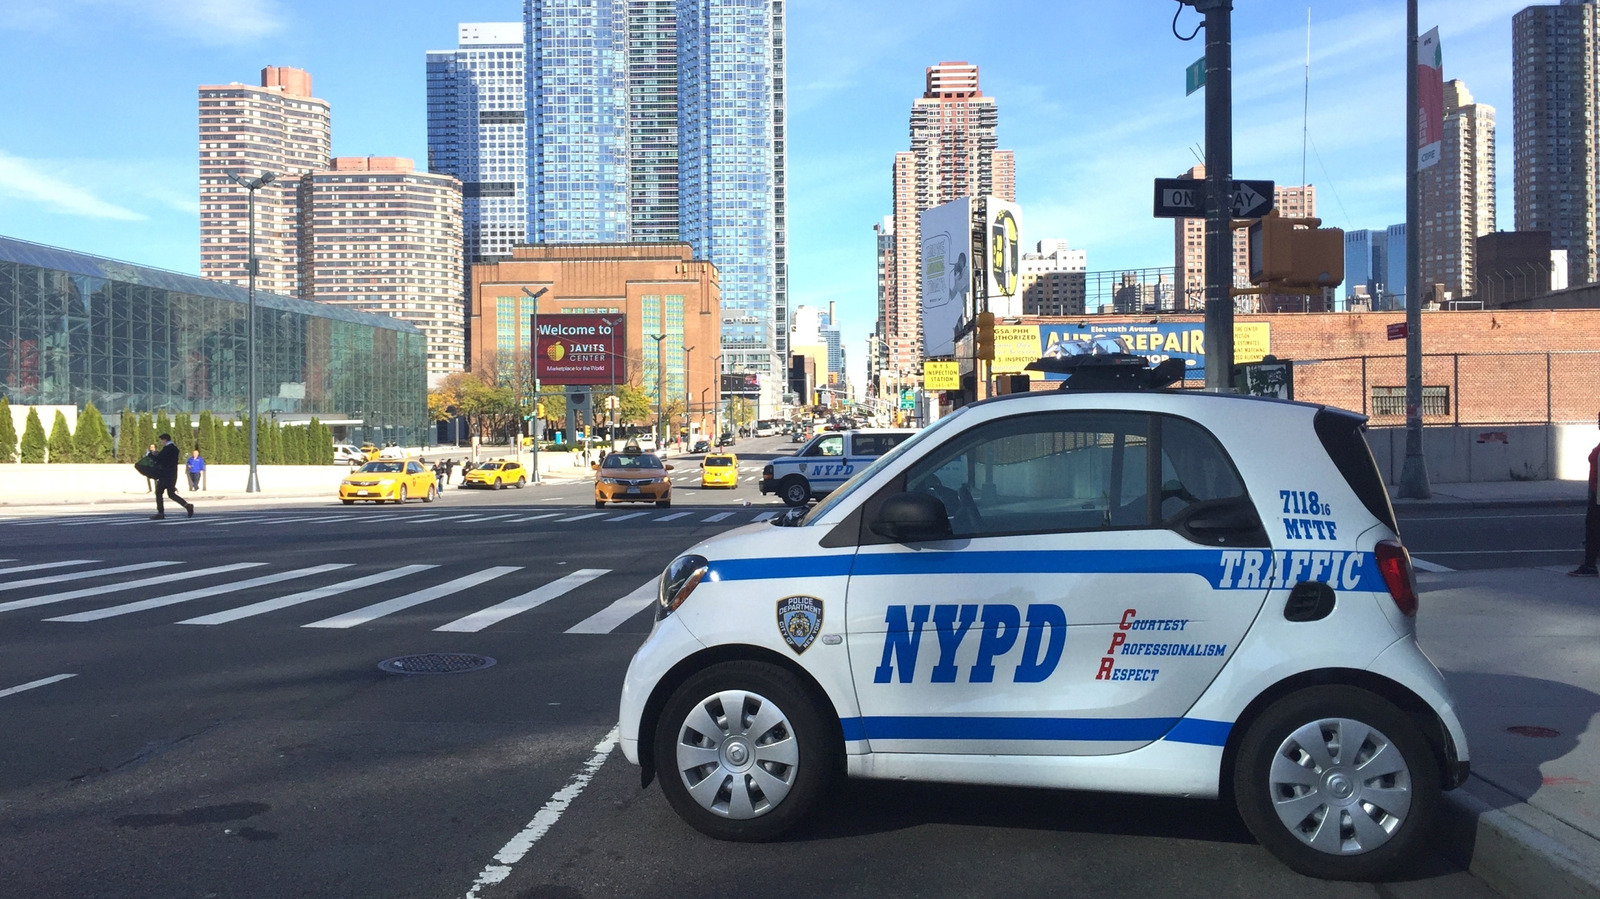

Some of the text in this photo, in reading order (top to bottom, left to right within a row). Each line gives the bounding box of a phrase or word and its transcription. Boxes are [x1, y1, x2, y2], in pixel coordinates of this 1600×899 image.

[1172, 191, 1255, 207] ON AY
[539, 324, 612, 335] Welcome to
[570, 344, 605, 352] JAVITS
[812, 464, 855, 476] NYPD
[1279, 489, 1321, 516] 7118
[1282, 518, 1337, 541] MTTF
[1219, 550, 1365, 590] TRAFFIC
[779, 603, 822, 615] DEPARTMENT
[788, 597, 814, 605] POLICE
[1119, 608, 1189, 631] COURTESY
[779, 621, 795, 645] CITY OF
[803, 618, 822, 648] NEW YORK
[873, 603, 1067, 684] NYPD
[1107, 632, 1227, 656] PROFESSIONALISM
[1095, 657, 1160, 681] RESPECT
